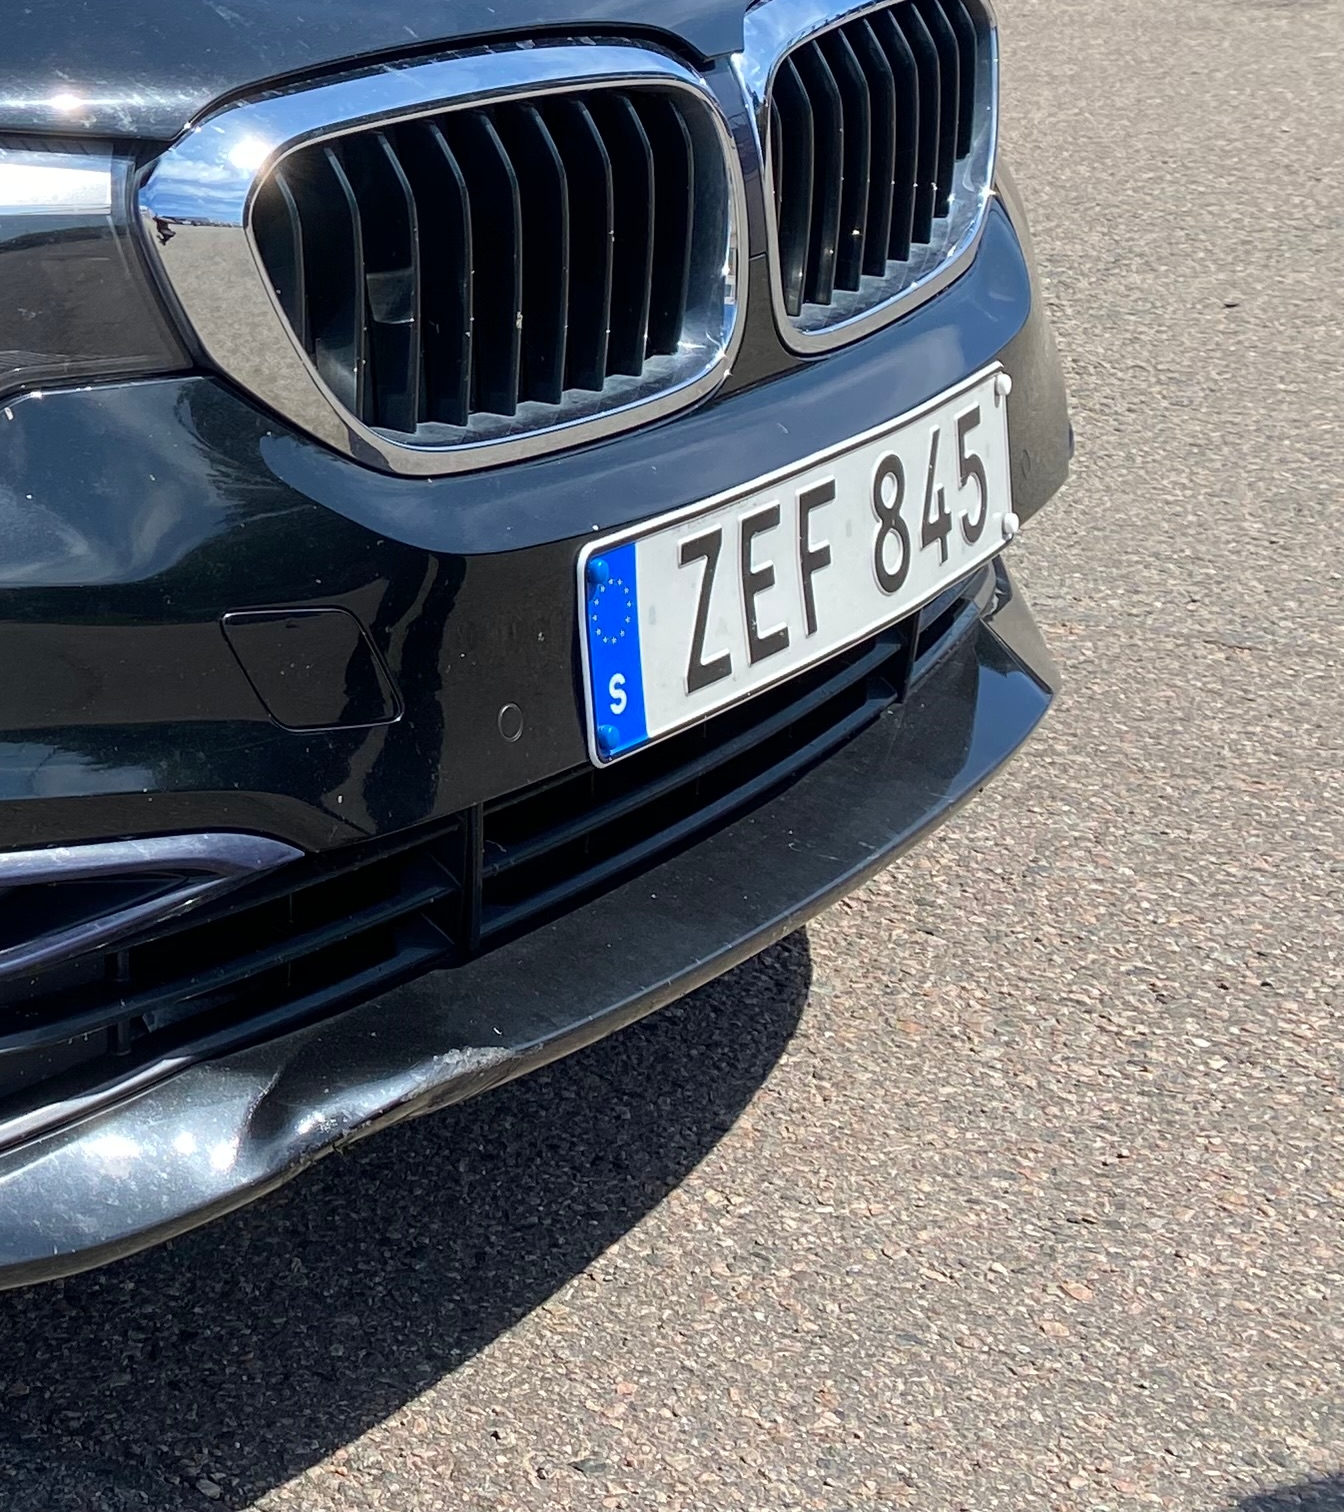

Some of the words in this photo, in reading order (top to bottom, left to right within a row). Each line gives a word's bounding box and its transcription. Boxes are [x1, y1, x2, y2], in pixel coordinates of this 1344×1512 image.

[678, 478, 837, 695] ZEF
[872, 403, 989, 595] 845
[608, 672, 628, 716] S
